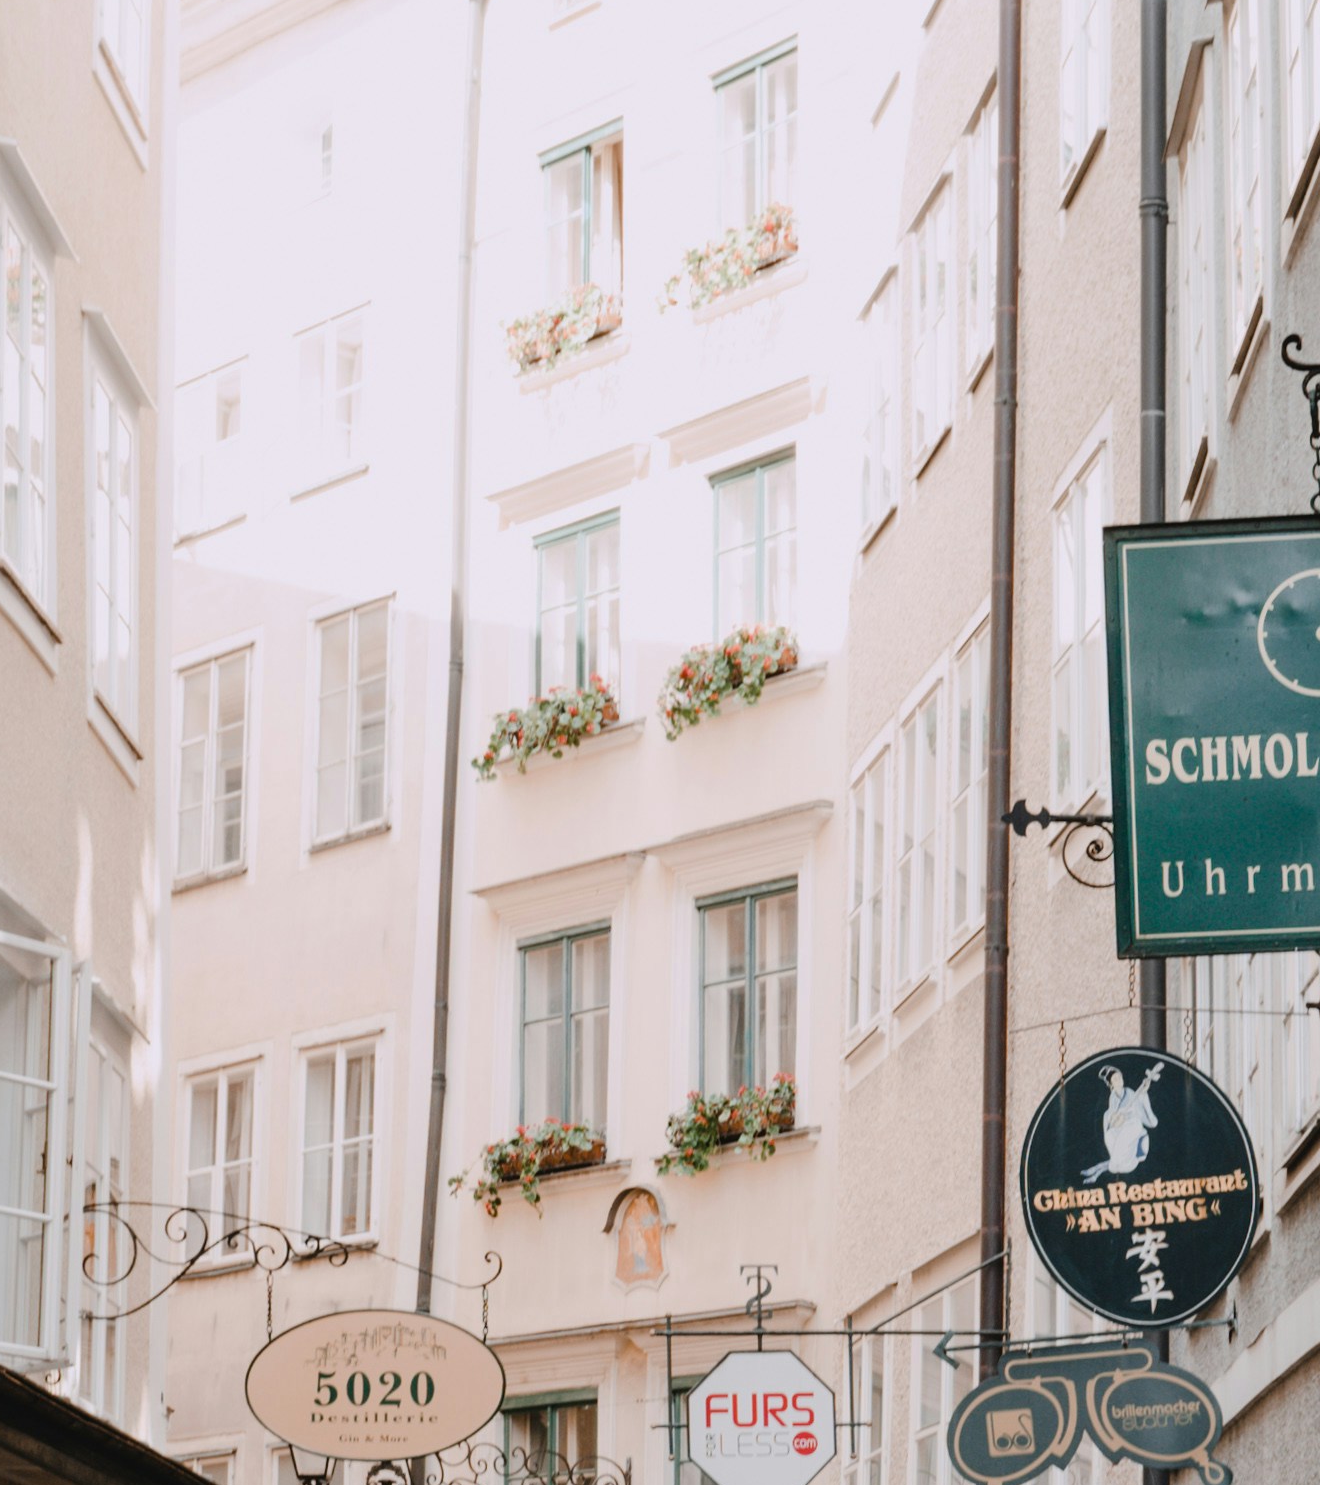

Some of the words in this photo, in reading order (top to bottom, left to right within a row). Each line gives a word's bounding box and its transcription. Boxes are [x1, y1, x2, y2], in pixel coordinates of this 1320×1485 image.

[1033, 1186, 1105, 1212] China
[1107, 1168, 1248, 1205] Restaurant
[313, 1370, 435, 1408] 5020
[311, 1412, 439, 1424] Destillerie
[705, 1392, 815, 1428] FURS
[1111, 1399, 1201, 1420] brillenmacher
[339, 1434, 360, 1443] Gin
[365, 1434, 374, 1443] &
[380, 1434, 409, 1443] More
[720, 1431, 790, 1458] LESS
